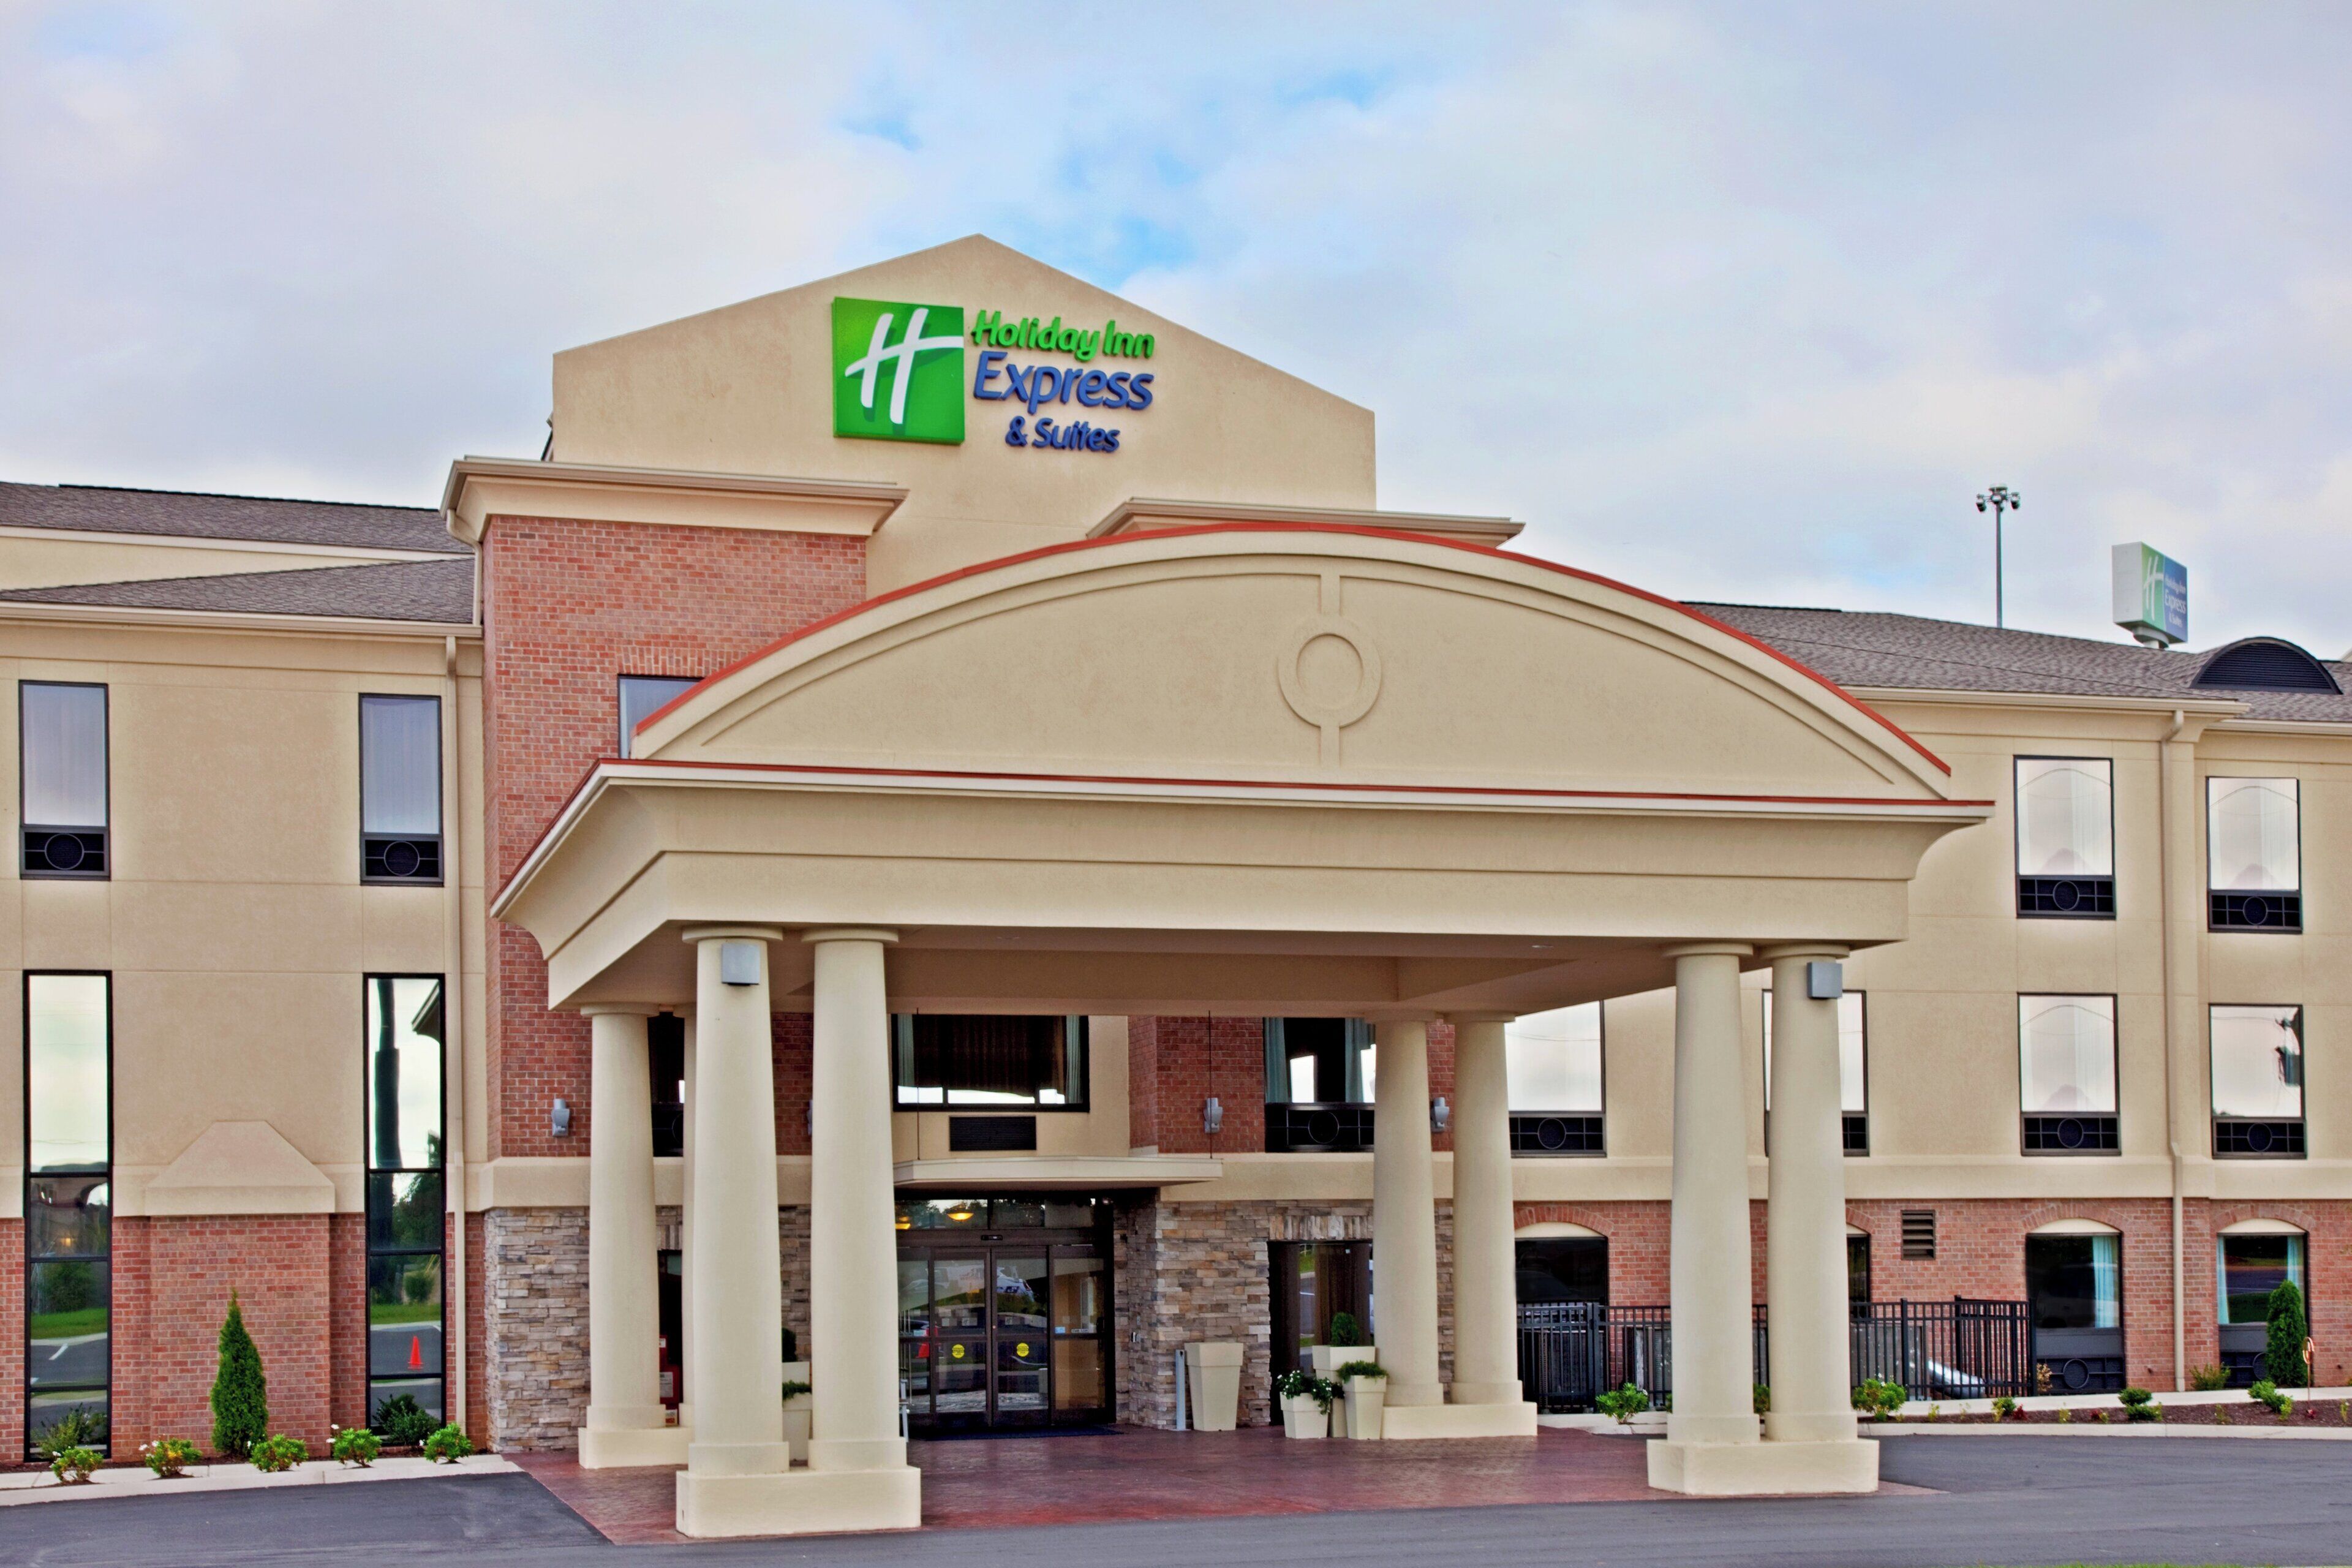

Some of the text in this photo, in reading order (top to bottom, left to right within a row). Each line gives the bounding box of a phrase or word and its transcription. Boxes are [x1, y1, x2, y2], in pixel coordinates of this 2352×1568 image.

[971, 309, 1155, 362] Holiday Inn
[973, 350, 1155, 415] Express
[1005, 415, 1120, 453] & Suites
[2165, 589, 2186, 614] Express
